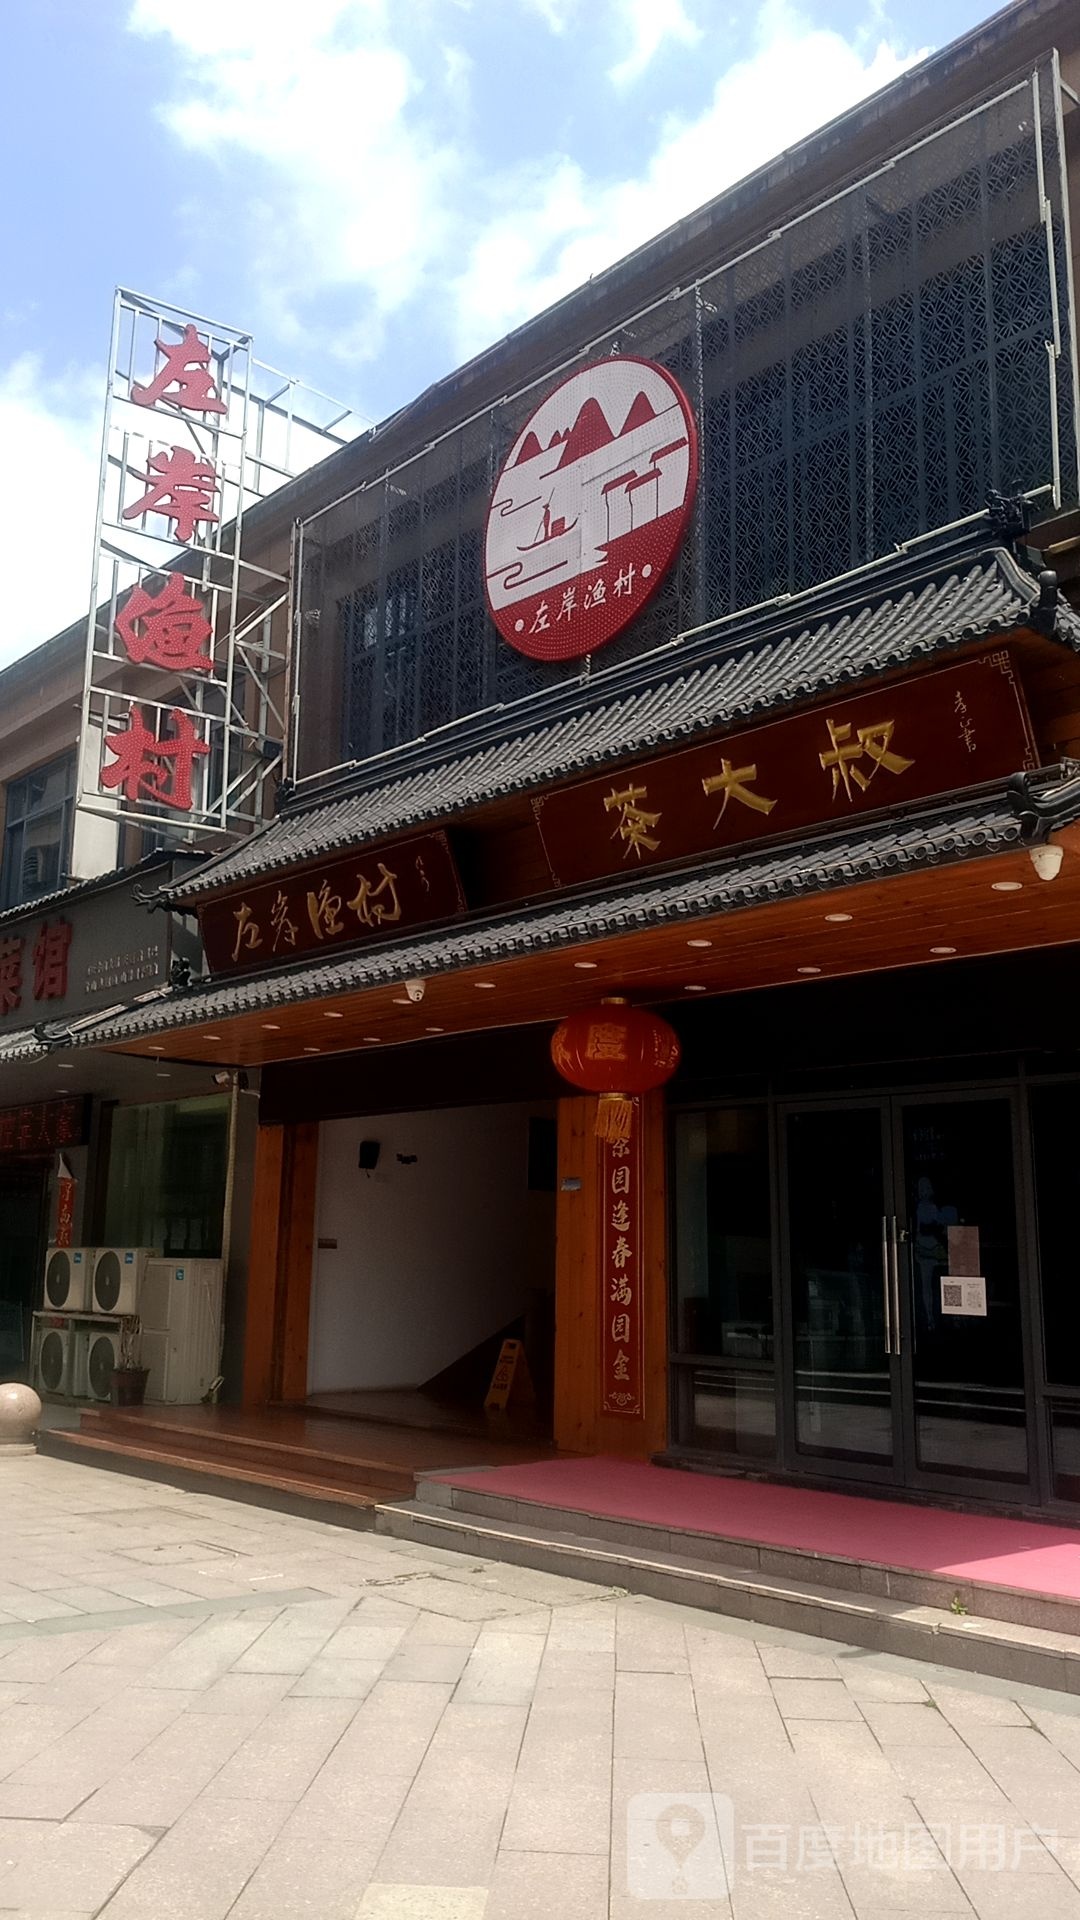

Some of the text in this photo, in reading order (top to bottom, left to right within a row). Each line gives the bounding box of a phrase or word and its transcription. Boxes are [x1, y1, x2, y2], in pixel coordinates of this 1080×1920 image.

[101, 324, 227, 810] 左岸渔村
[529, 563, 636, 634] 左岸渔村
[603, 718, 915, 860] 茶大叔
[231, 862, 402, 962] 左岸渔村
